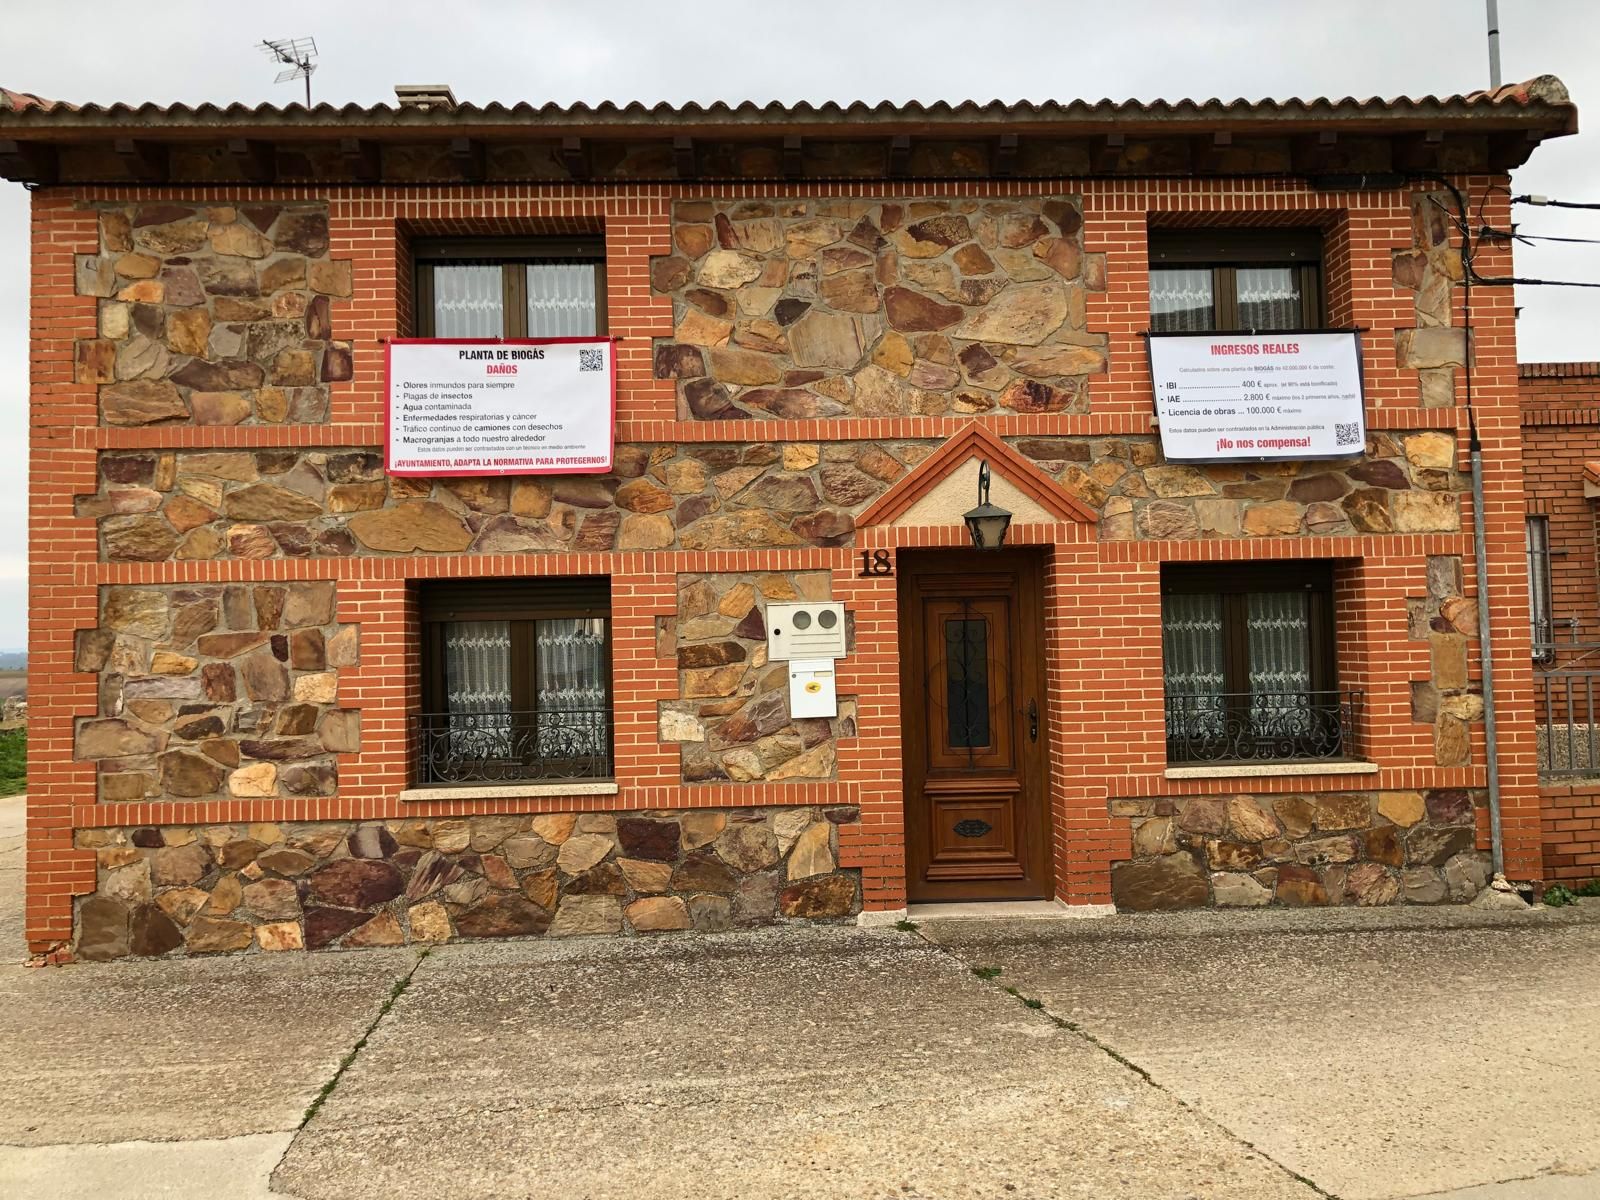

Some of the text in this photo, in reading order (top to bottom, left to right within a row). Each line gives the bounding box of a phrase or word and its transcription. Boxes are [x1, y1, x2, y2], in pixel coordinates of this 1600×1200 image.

[459, 348, 544, 360] PLANTA DE BIOGÁS
[1210, 343, 1300, 356] INGRESOS REALES
[486, 363, 518, 374] DAÑOS
[486, 381, 515, 390] siempre
[1166, 382, 1177, 390] IBI
[1242, 380, 1256, 388] 400
[1257, 380, 1262, 388] €
[403, 392, 428, 401] Plagas
[403, 403, 422, 412] Agua
[1168, 408, 1200, 416] Licencia
[1277, 406, 1282, 414] €
[459, 414, 504, 422] respiratorias
[403, 436, 454, 444] Macrogranjas
[1216, 436, 1311, 452] ¡No nos compensa!
[394, 456, 608, 468] ¡AYUNTAMIENTO, ADAPTA LA NORMATIVA PARA PROTEGERNOS!
[858, 548, 894, 577] 18
